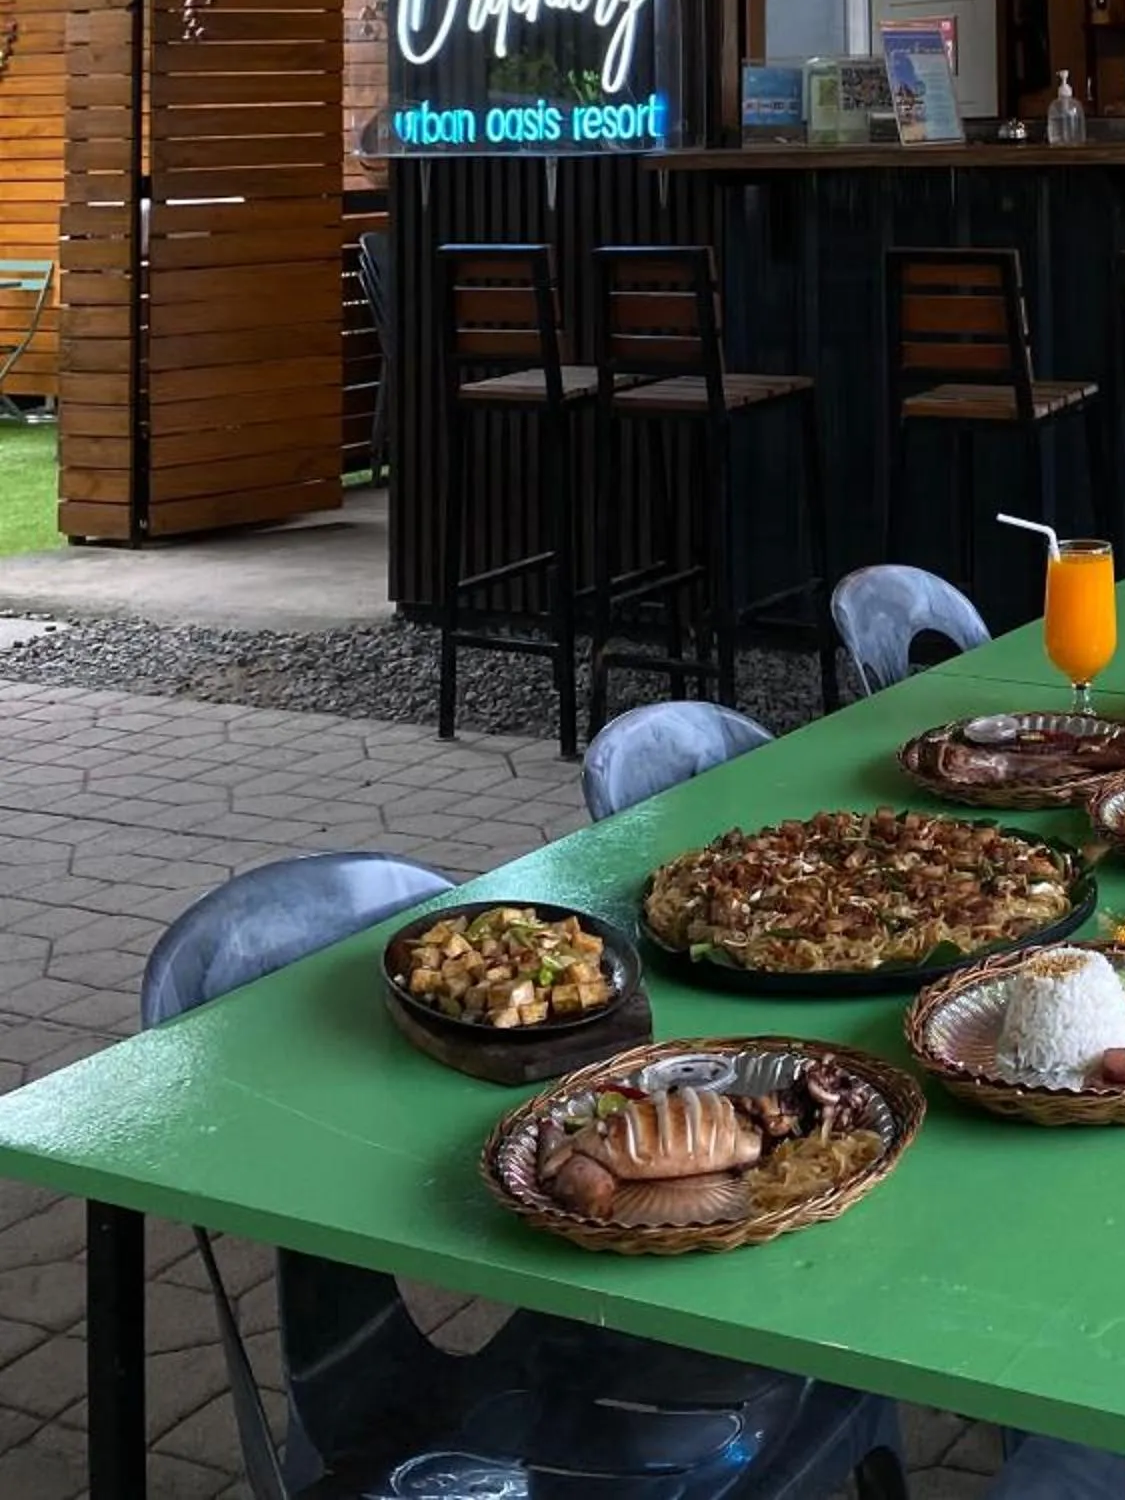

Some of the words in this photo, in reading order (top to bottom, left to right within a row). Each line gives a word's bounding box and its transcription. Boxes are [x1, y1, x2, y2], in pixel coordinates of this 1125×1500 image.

[394, 99, 476, 145] urban
[485, 99, 562, 143] oasis
[572, 94, 665, 141] resort
